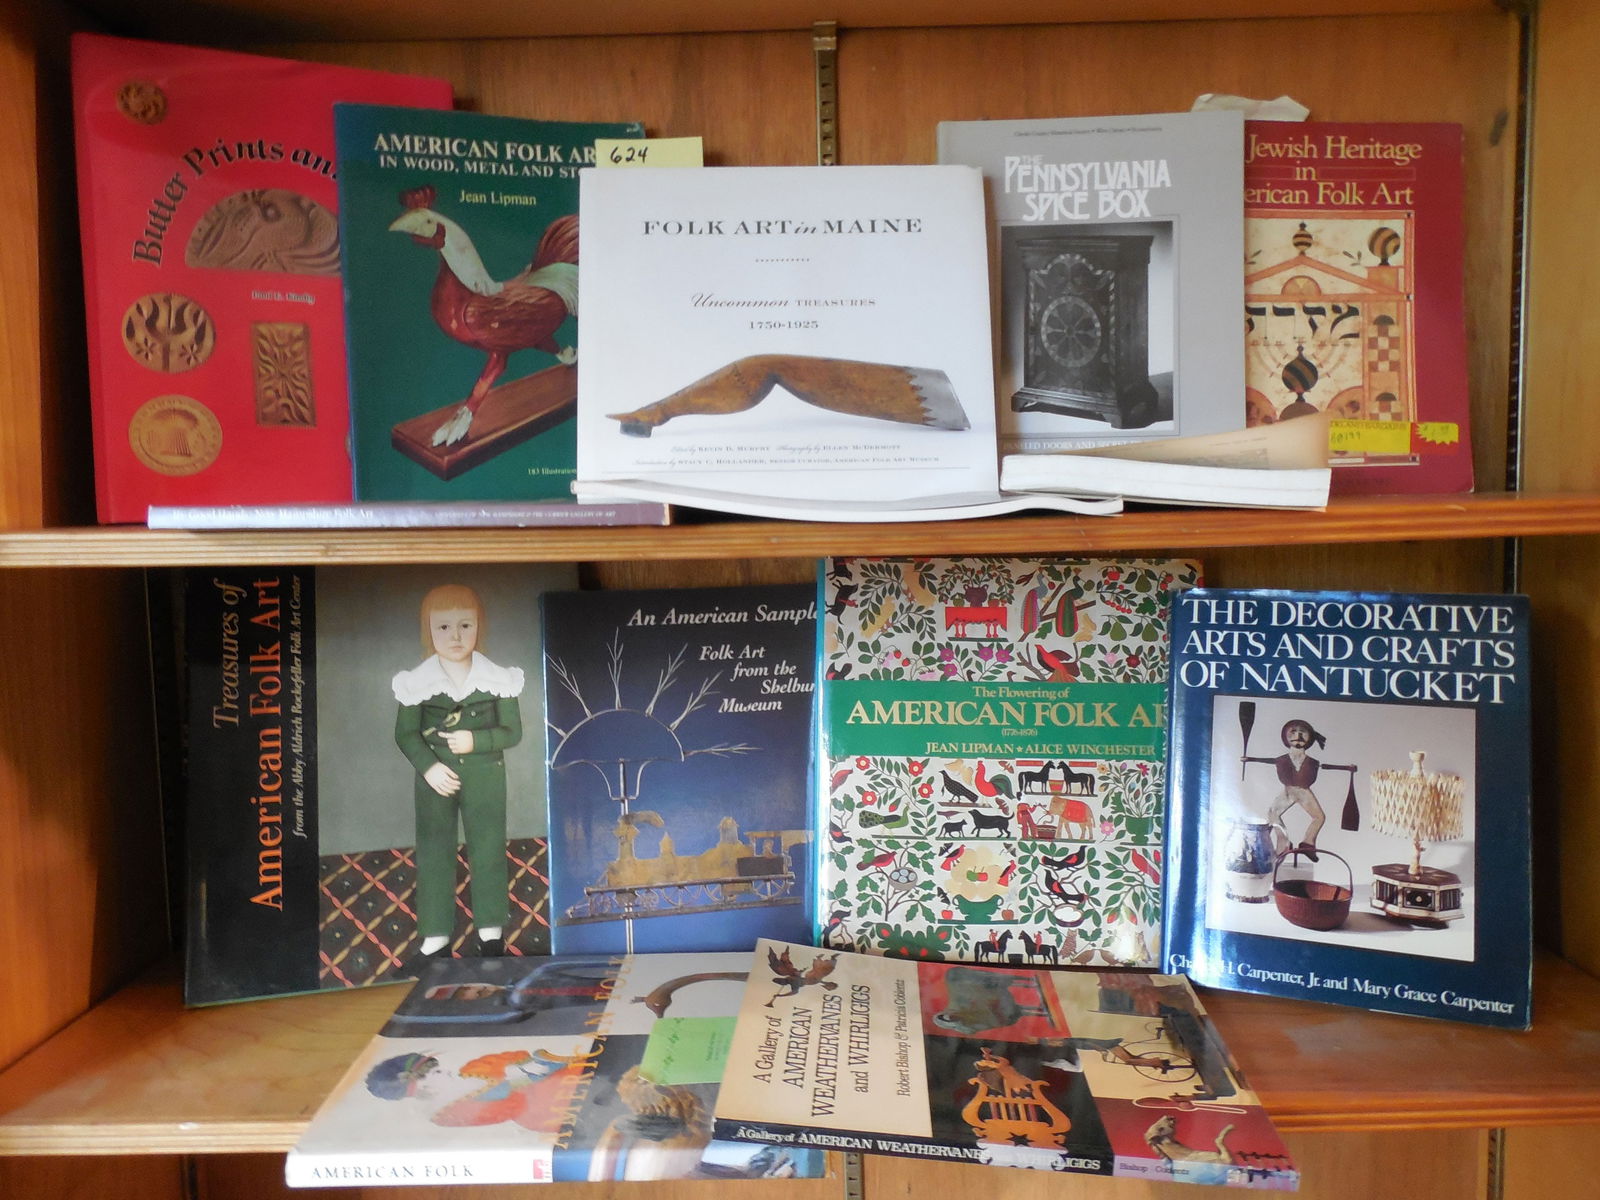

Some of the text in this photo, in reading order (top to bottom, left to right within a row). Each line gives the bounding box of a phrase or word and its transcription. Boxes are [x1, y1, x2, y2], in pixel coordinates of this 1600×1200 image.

[373, 133, 596, 164] AMERICAN FOLK AR
[609, 146, 649, 165] 624
[1021, 154, 1043, 164] THE
[1246, 134, 1423, 166] Jewish Heritage
[379, 154, 397, 167] IN
[403, 157, 460, 174] WOOD,
[464, 160, 518, 177] METAL
[522, 164, 554, 178] AND
[1004, 156, 1172, 194] PENNSYLVANIA
[1295, 160, 1317, 181] in
[132, 137, 338, 267] Butter Prints an
[459, 189, 537, 207] Jean Lipman
[1022, 190, 1151, 222] SPICE BOX
[1315, 181, 1365, 205] Folk
[1371, 182, 1414, 205] Art
[642, 218, 923, 236] FOLK ART in MAINE
[690, 292, 877, 309] Uncommon TREASURES
[750, 320, 819, 330] 1750-1925
[290, 612, 302, 630] Art
[627, 608, 656, 627] An
[661, 606, 749, 626] American
[1181, 598, 1516, 636] THE DECORATIVE
[212, 577, 248, 729] Treasures of
[290, 631, 302, 655] Folk
[699, 644, 766, 661] Folk Art
[1181, 630, 1516, 669] ARTS AND CRAFTS
[290, 655, 306, 714] Rockefeller
[730, 660, 797, 682] from the
[1180, 659, 1517, 704] OF NANTUCKET
[718, 697, 783, 714] Museum
[972, 685, 1071, 701] The Flowering of
[846, 699, 1026, 727] AMERICAN
[1033, 700, 1120, 728] FOLK
[249, 575, 283, 912] American Folk Art
[291, 716, 303, 757] Aldrich
[925, 742, 1155, 757] JEAN LIPMAN ALICE WINCHESTER
[291, 758, 307, 789] Abby
[291, 788, 304, 807] the
[292, 810, 308, 839] from
[1237, 962, 1306, 987] Carpenter,
[1322, 976, 1349, 991] and
[1352, 977, 1391, 998] Mary
[1394, 983, 1437, 1004] Grace
[1440, 990, 1516, 1016] Carpenter
[894, 1005, 907, 1032] Patricia
[753, 1015, 785, 1084] A Gallery of
[782, 1006, 813, 1089] AMERICAN
[848, 984, 871, 1094] and WHIRLIGIGS
[811, 993, 843, 1117] WEATHERVANES
[895, 1042, 912, 1068] Bishop
[896, 1067, 911, 1097] Robert
[736, 1125, 747, 1138] A
[746, 1128, 783, 1143] Gallery
[784, 1133, 795, 1142] of
[798, 1133, 873, 1149] AMERICAN
[876, 1139, 984, 1160] WEATHERVANE
[311, 1164, 416, 1180] AMERICAN
